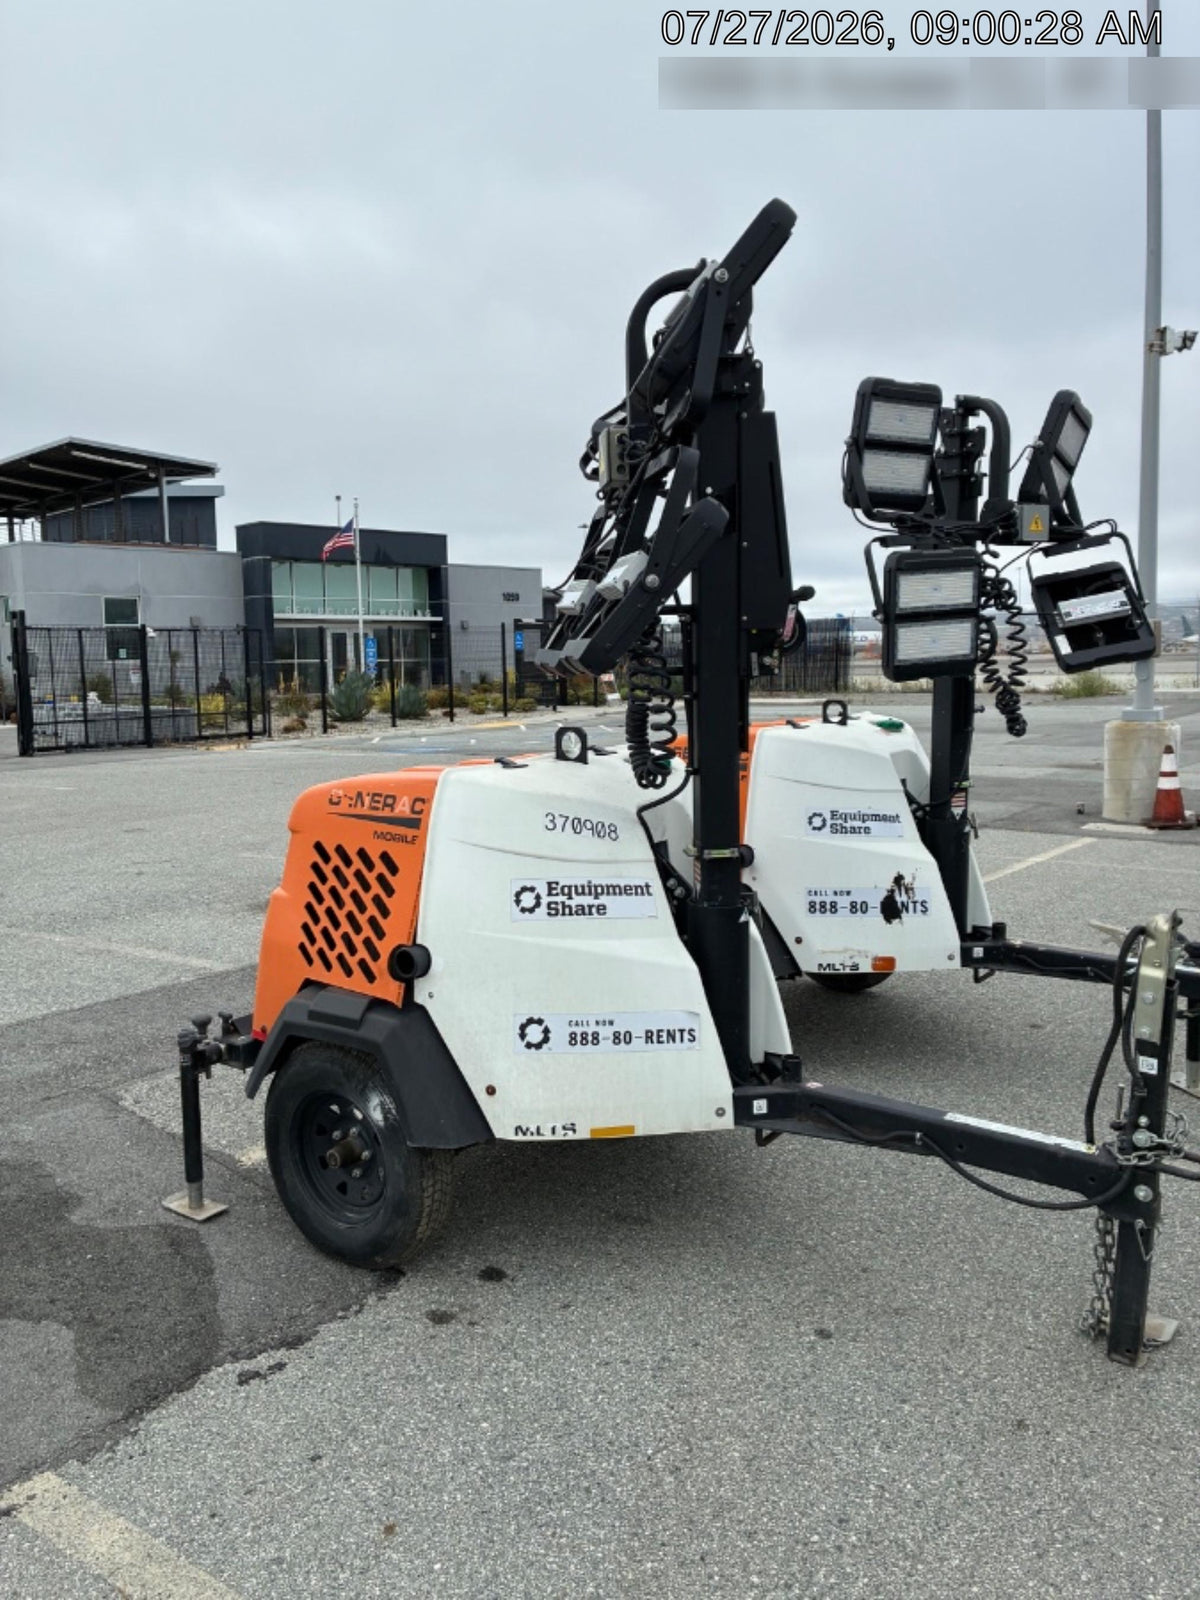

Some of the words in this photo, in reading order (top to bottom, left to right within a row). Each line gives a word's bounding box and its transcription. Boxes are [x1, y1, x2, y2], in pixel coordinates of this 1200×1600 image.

[829, 810, 902, 824] Equipment
[544, 812, 620, 842] 370908
[829, 823, 872, 835] Share
[373, 830, 419, 846] MOBILE
[546, 880, 653, 900] Equipment
[546, 901, 608, 917] Share
[568, 1019, 591, 1028] CALL
[595, 1019, 615, 1028] NOW
[568, 1028, 697, 1047] 888-80-RENTS
